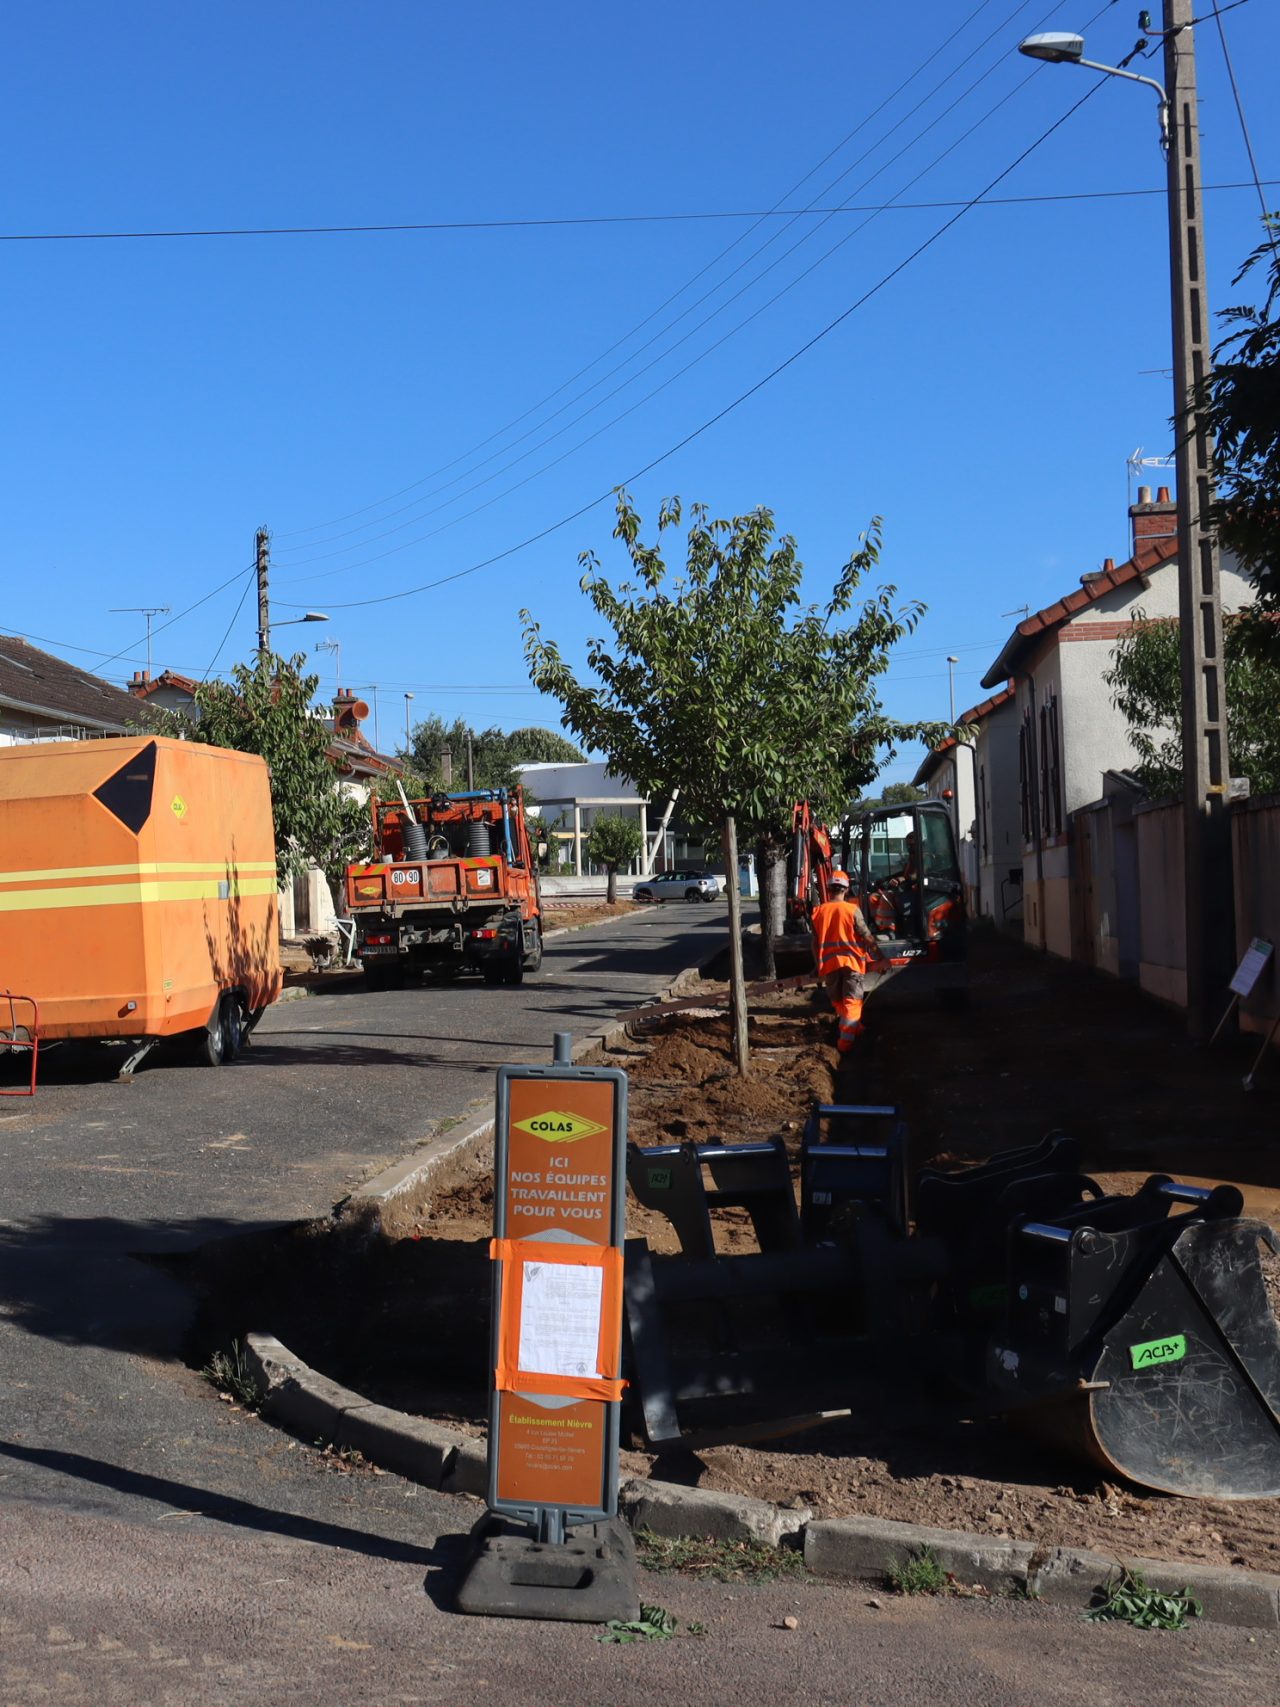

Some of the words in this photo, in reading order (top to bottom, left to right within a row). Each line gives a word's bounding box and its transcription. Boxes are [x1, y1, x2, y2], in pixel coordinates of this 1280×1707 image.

[393, 872, 403, 883] 80
[409, 871, 418, 883] 90
[530, 1121, 573, 1132] COLAS
[549, 1157, 569, 1168] ICI
[511, 1171, 541, 1183] NOS
[546, 1171, 607, 1186] ÉQUIPES
[511, 1188, 607, 1202] TRAVAILLENT
[513, 1205, 555, 1217] POUR
[560, 1207, 602, 1219] VOUS
[509, 1413, 565, 1428] Établissement
[567, 1419, 593, 1429] Nièvre
